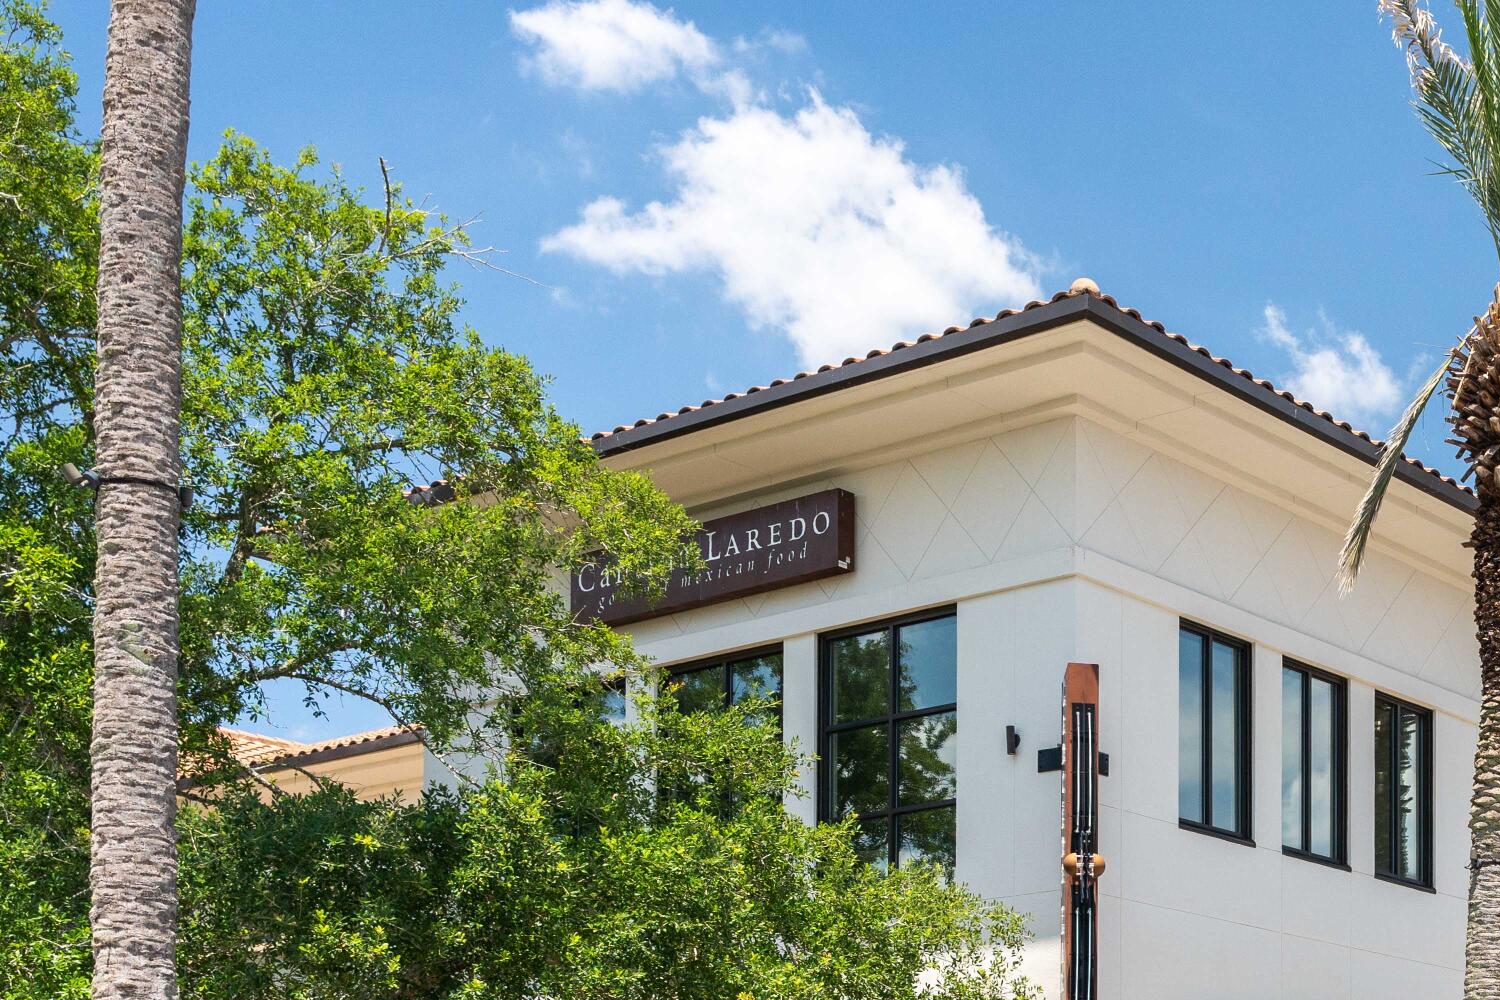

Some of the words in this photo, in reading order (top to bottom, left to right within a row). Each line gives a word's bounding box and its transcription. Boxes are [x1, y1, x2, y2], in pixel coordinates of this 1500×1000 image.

[705, 511, 831, 562] LAREDO
[681, 560, 755, 588] mexican
[763, 541, 808, 574] food
